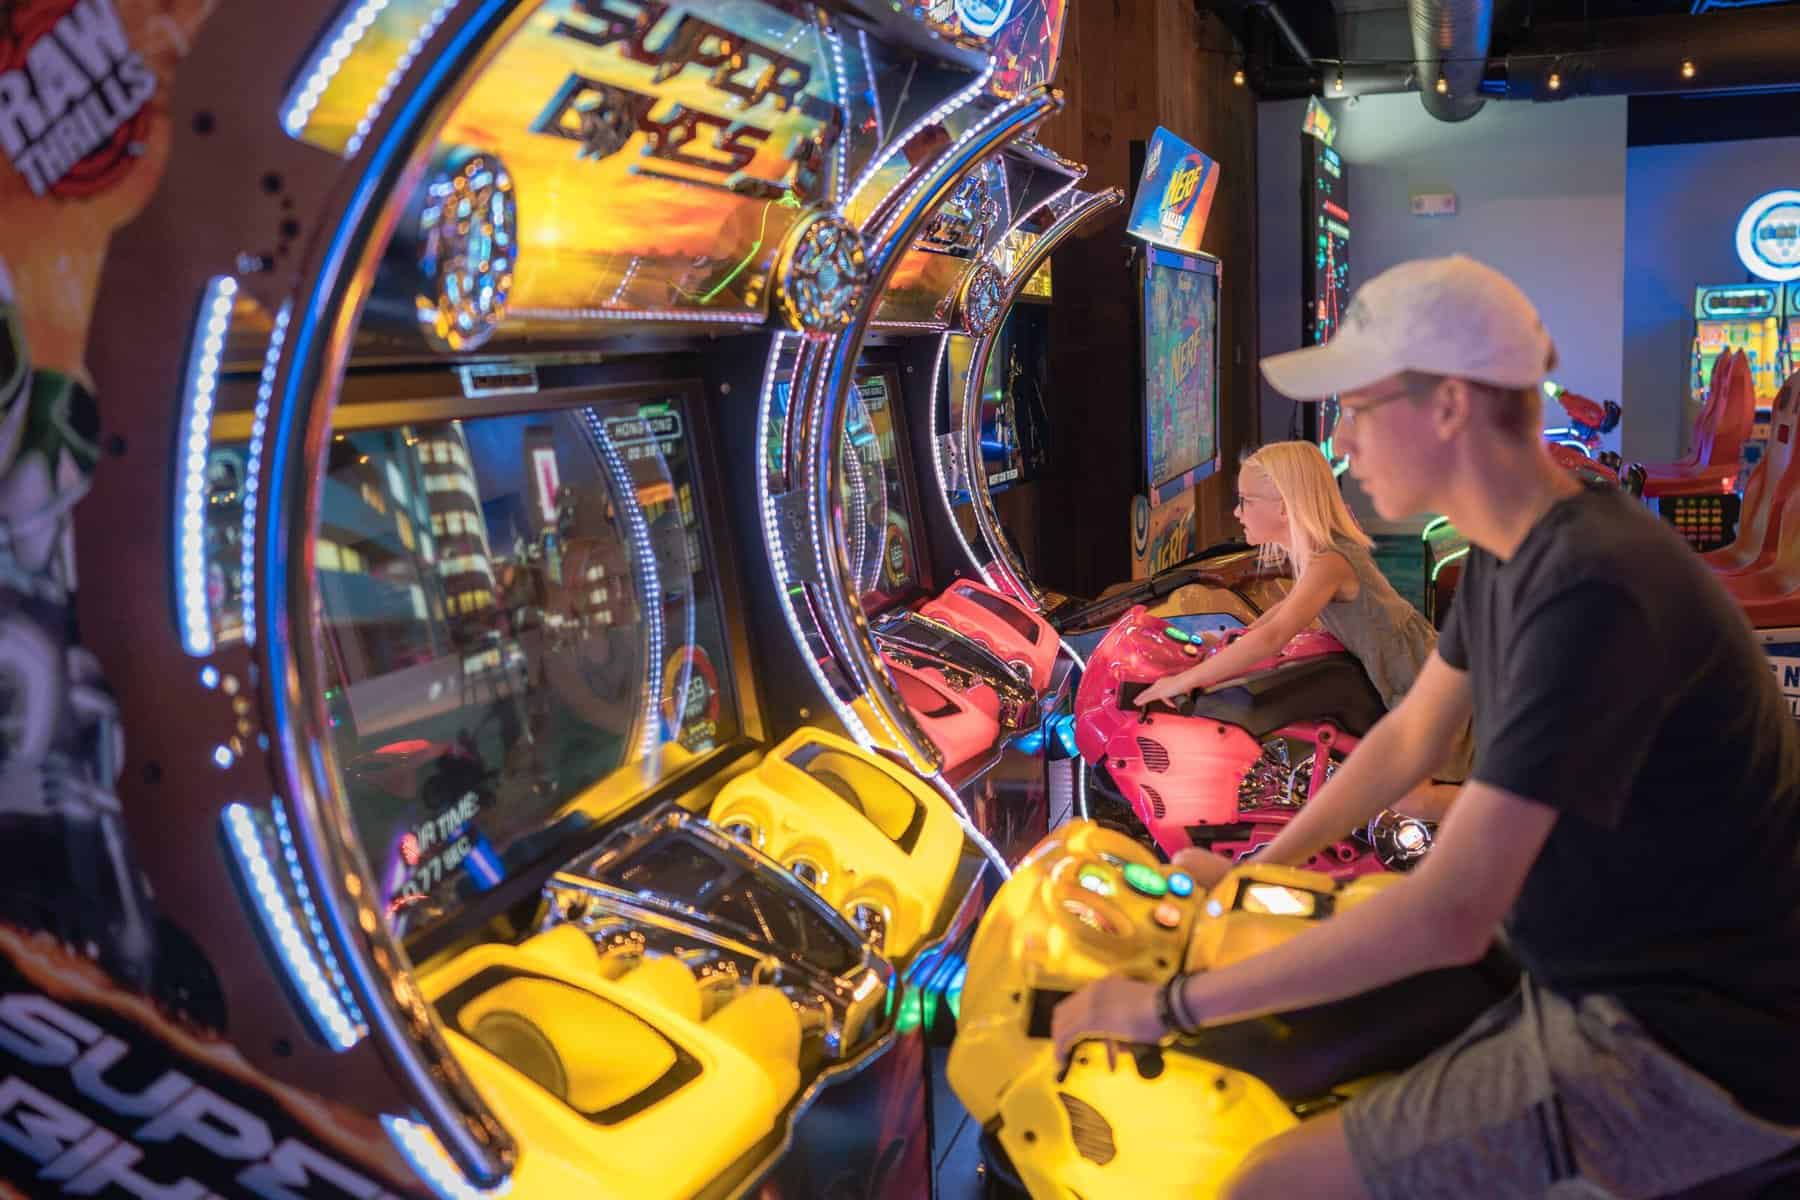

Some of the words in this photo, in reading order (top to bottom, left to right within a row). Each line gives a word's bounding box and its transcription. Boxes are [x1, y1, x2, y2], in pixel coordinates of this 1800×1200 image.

[0, 0, 130, 158] RAW
[13, 50, 157, 198] THRILLS
[1161, 164, 1203, 213] NERF
[1169, 327, 1201, 397] NERF
[0, 993, 402, 1200] SUPE
[0, 1075, 227, 1200] BIK
